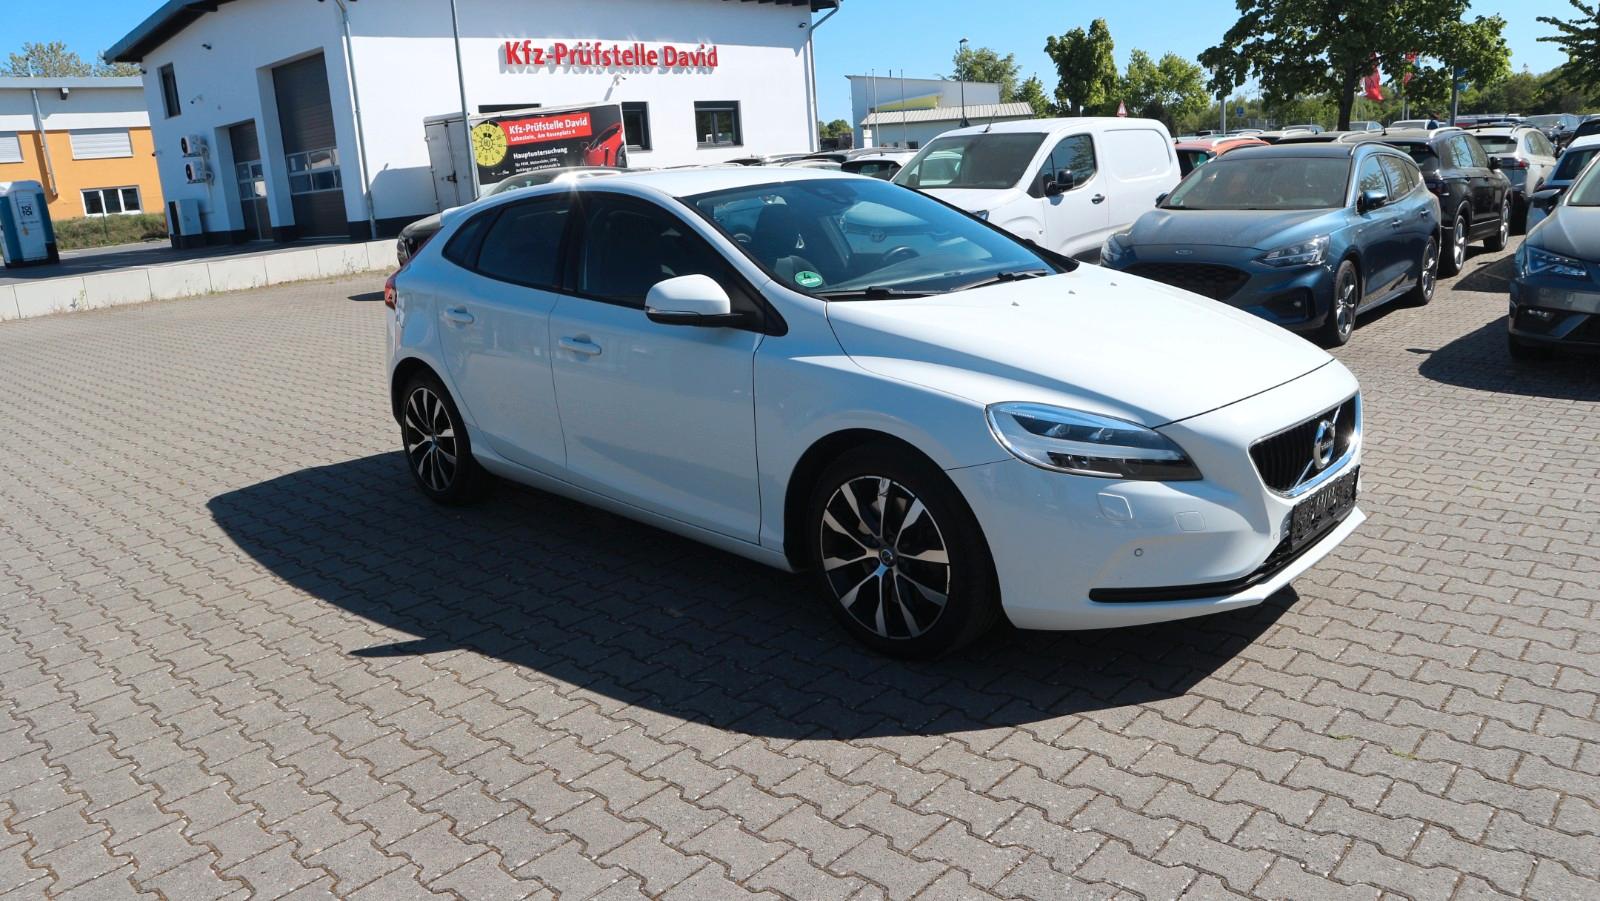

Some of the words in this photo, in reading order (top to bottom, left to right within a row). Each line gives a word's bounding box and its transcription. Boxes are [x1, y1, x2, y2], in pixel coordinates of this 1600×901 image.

[504, 40, 659, 67] Kfz-Prüfstelle
[663, 43, 719, 68] David
[509, 120, 564, 135] Kfz-Prüfstelle
[565, 116, 588, 127] David
[513, 147, 568, 160] Hauptuntersuchung
